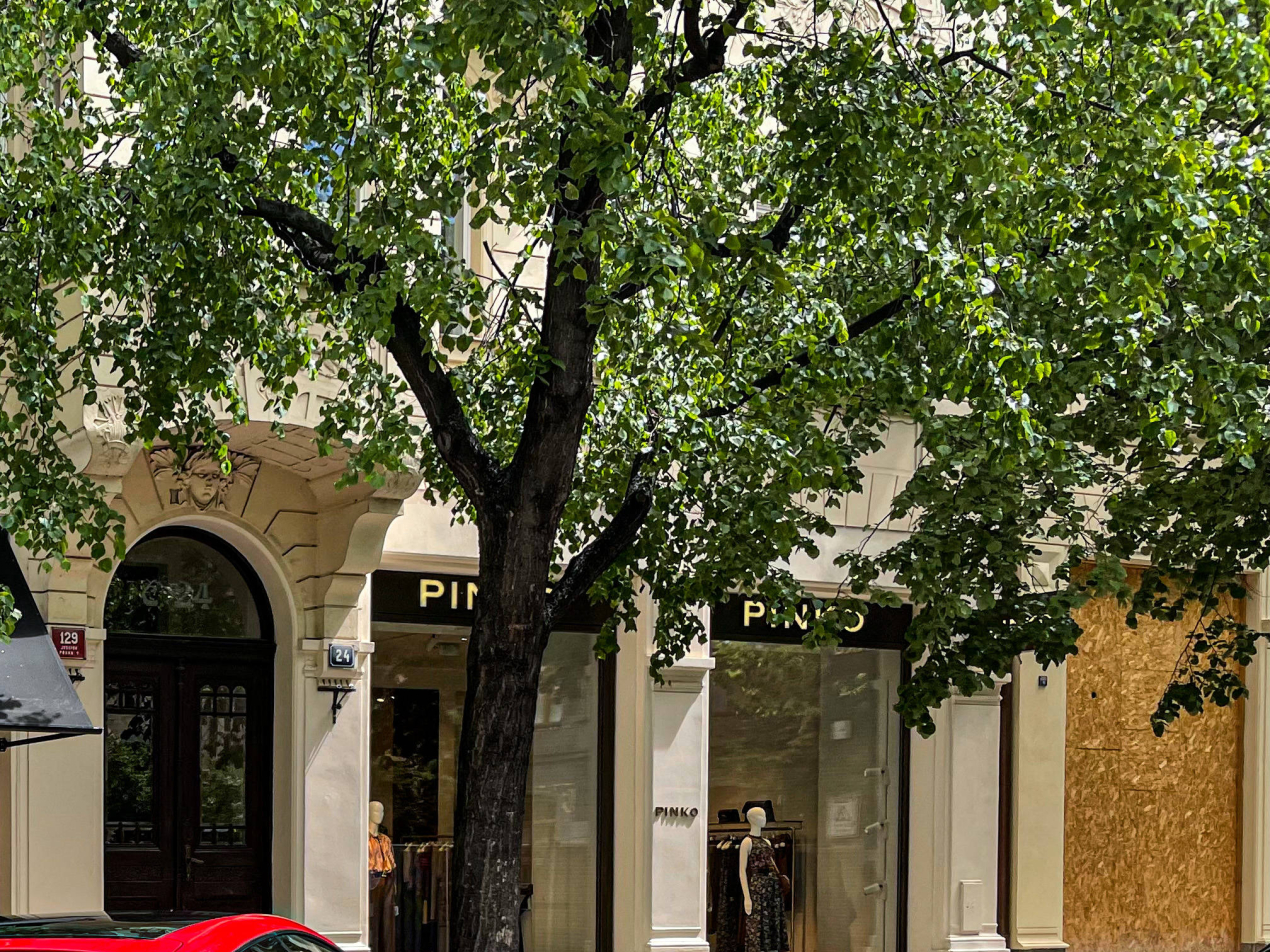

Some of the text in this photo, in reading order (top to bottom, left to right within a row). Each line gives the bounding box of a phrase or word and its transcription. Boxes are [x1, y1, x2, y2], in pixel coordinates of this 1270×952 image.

[60, 631, 78, 644] 129
[335, 649, 350, 662] 24
[655, 806, 698, 818] PINKO
